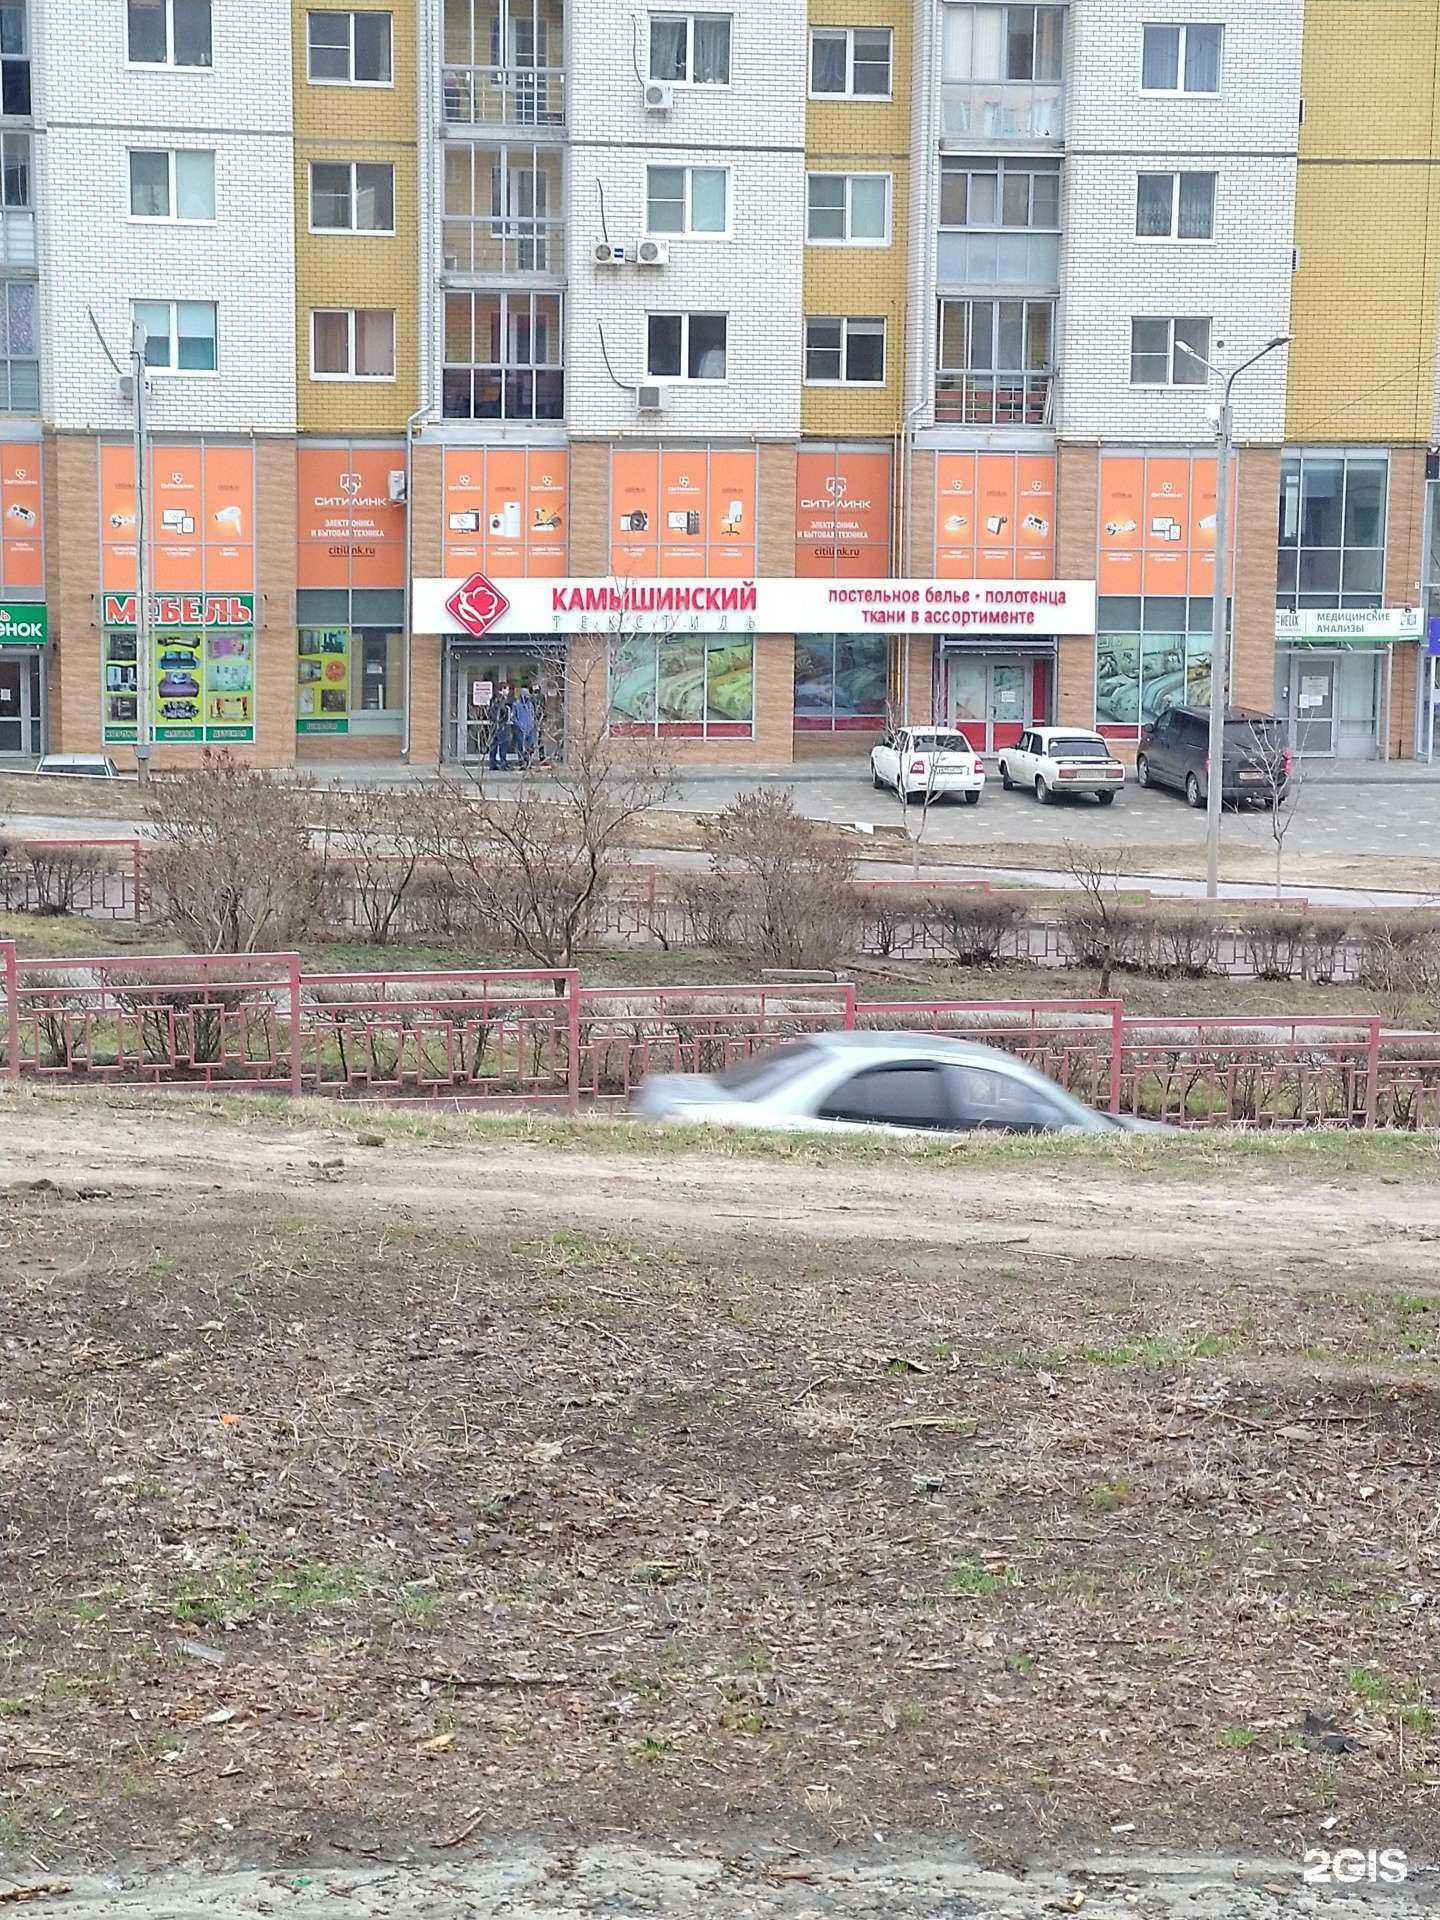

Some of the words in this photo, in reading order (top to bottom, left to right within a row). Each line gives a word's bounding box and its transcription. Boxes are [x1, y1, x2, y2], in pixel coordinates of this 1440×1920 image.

[314, 497, 387, 507] СИТИЛИНК
[801, 499, 871, 509] СИТИЛИНК
[328, 545, 376, 555] citilink.ru
[814, 547, 860, 556] citilink.ru
[551, 581, 758, 611] КАМЫШИНСКИЙ
[828, 588, 920, 603] постельное
[925, 587, 970, 603] белье
[985, 590, 1067, 606] полотенца
[862, 609, 906, 623] ткани
[911, 609, 919, 623] в
[924, 609, 1035, 626] ассортименте
[1317, 612, 1391, 622] МЕДИЦИНСКИЕ
[551, 615, 757, 631] ТЕКСТИЛЬ
[1317, 624, 1364, 633] АНАЛИЗЫ
